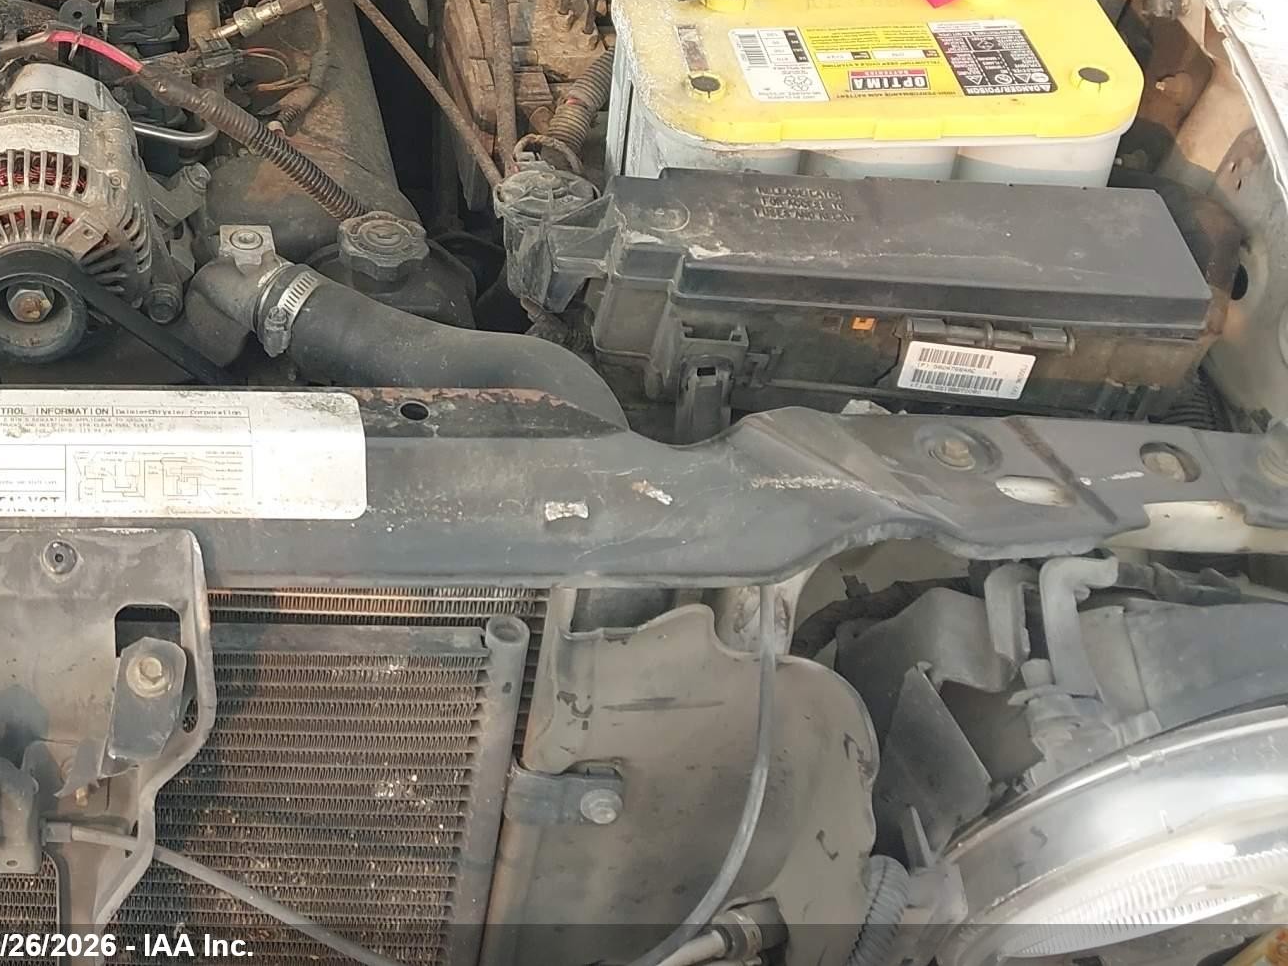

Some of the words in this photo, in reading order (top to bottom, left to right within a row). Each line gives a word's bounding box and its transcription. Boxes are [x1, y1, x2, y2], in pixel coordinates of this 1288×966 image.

[853, 76, 927, 89] OPTIMA
[965, 84, 1041, 94] DANGER/POISON
[36, 407, 109, 415] INFORMATION
